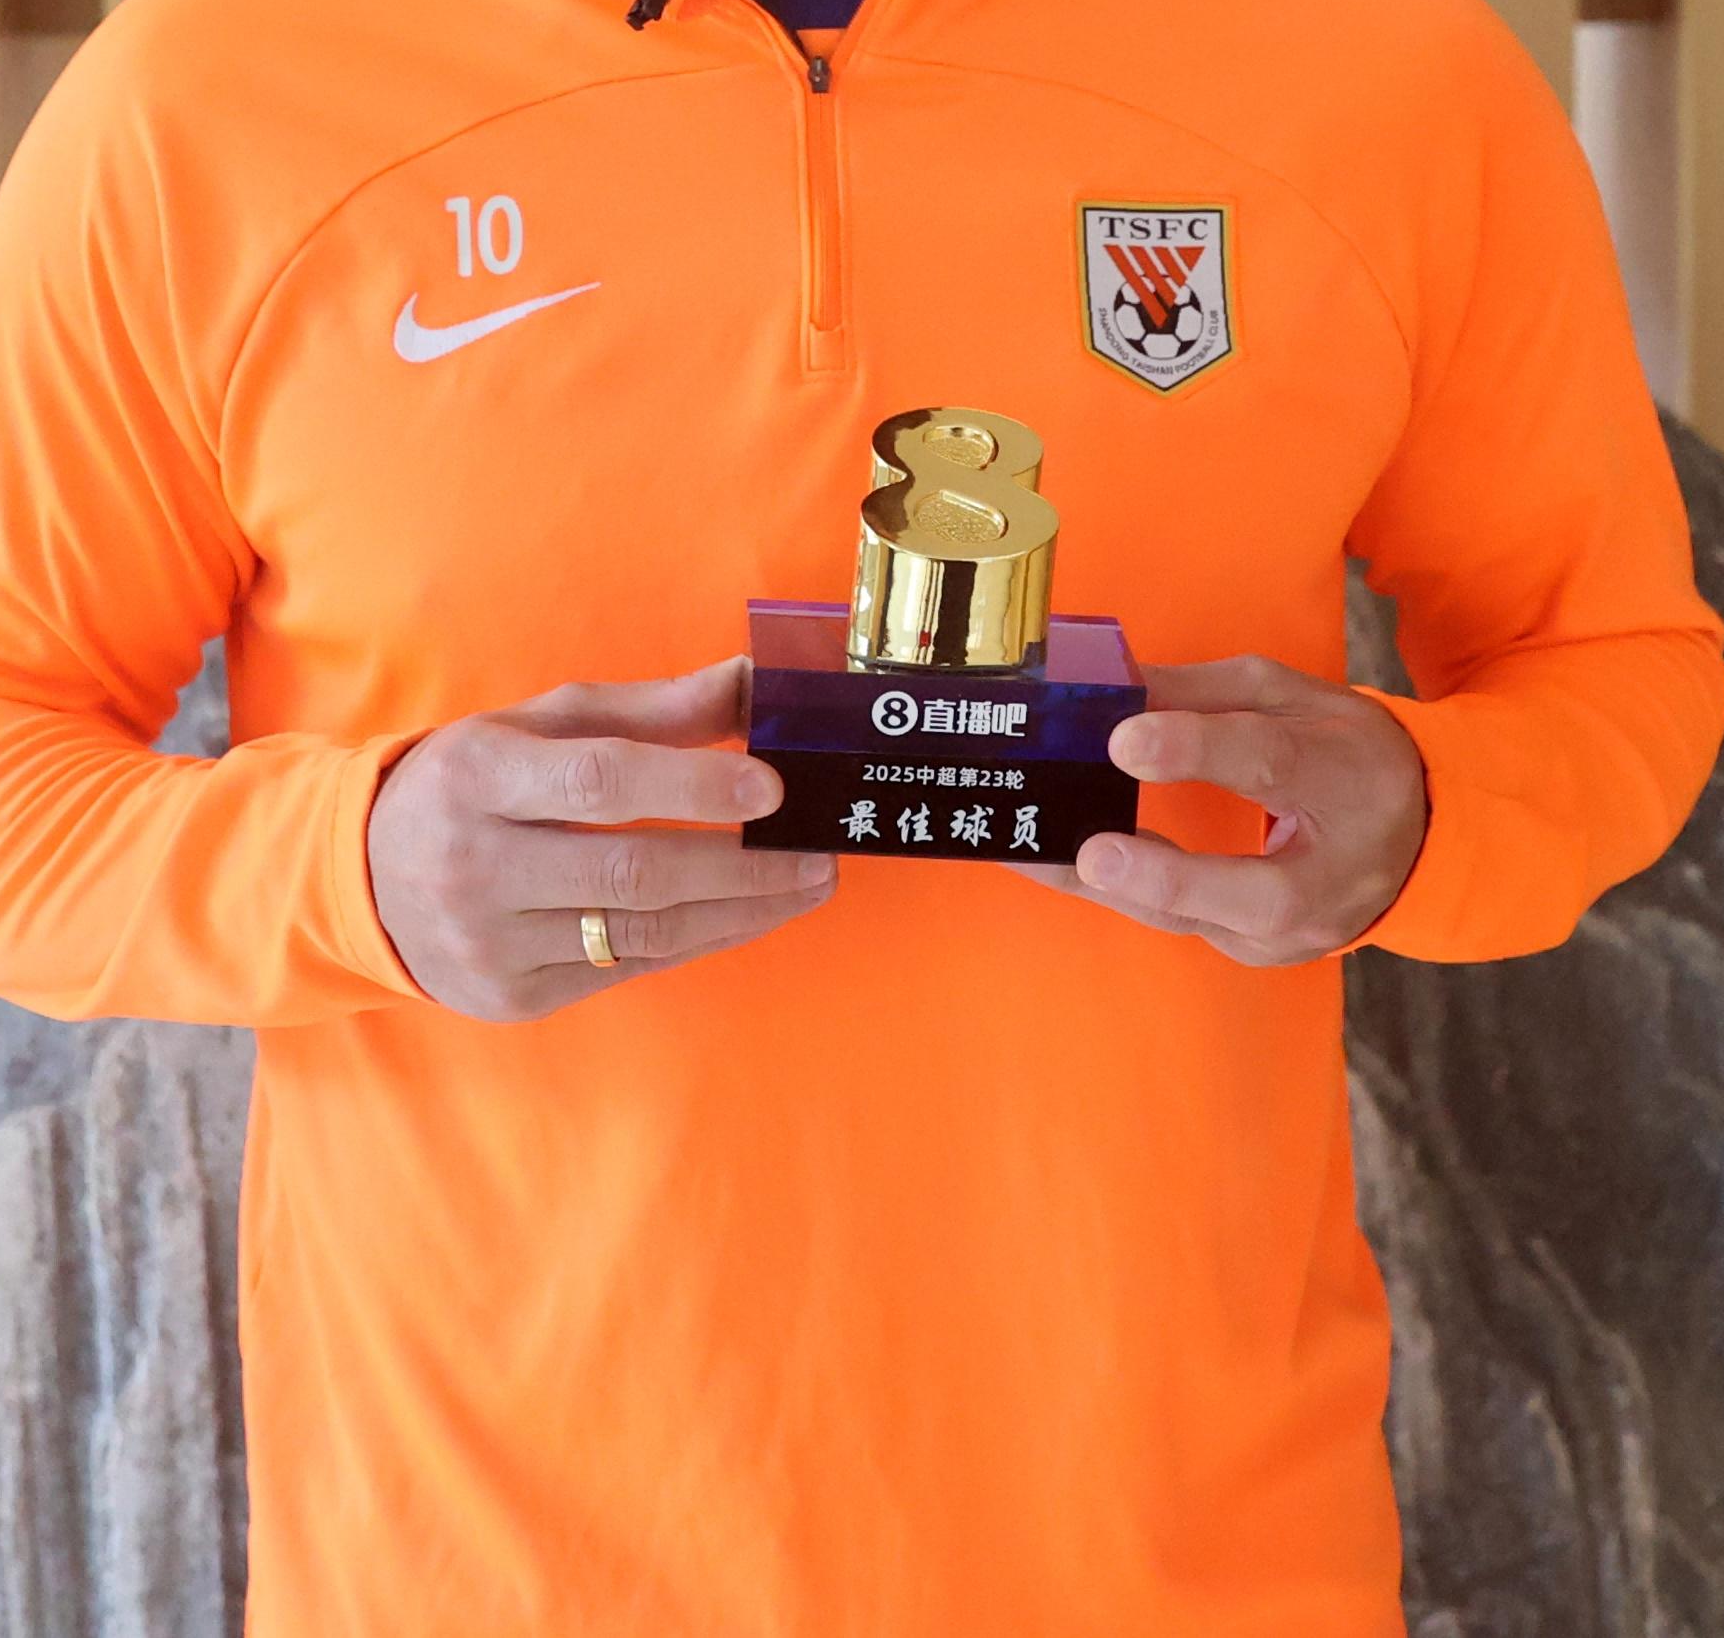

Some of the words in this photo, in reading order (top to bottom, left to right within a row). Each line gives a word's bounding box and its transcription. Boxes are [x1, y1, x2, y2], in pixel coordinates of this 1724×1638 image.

[444, 194, 524, 278] 10
[1098, 215, 1209, 241] TSFC
[920, 698, 1028, 737] 直播吧
[862, 764, 1026, 790] 2025中超第23轮
[838, 799, 1041, 853] 最佳球员
